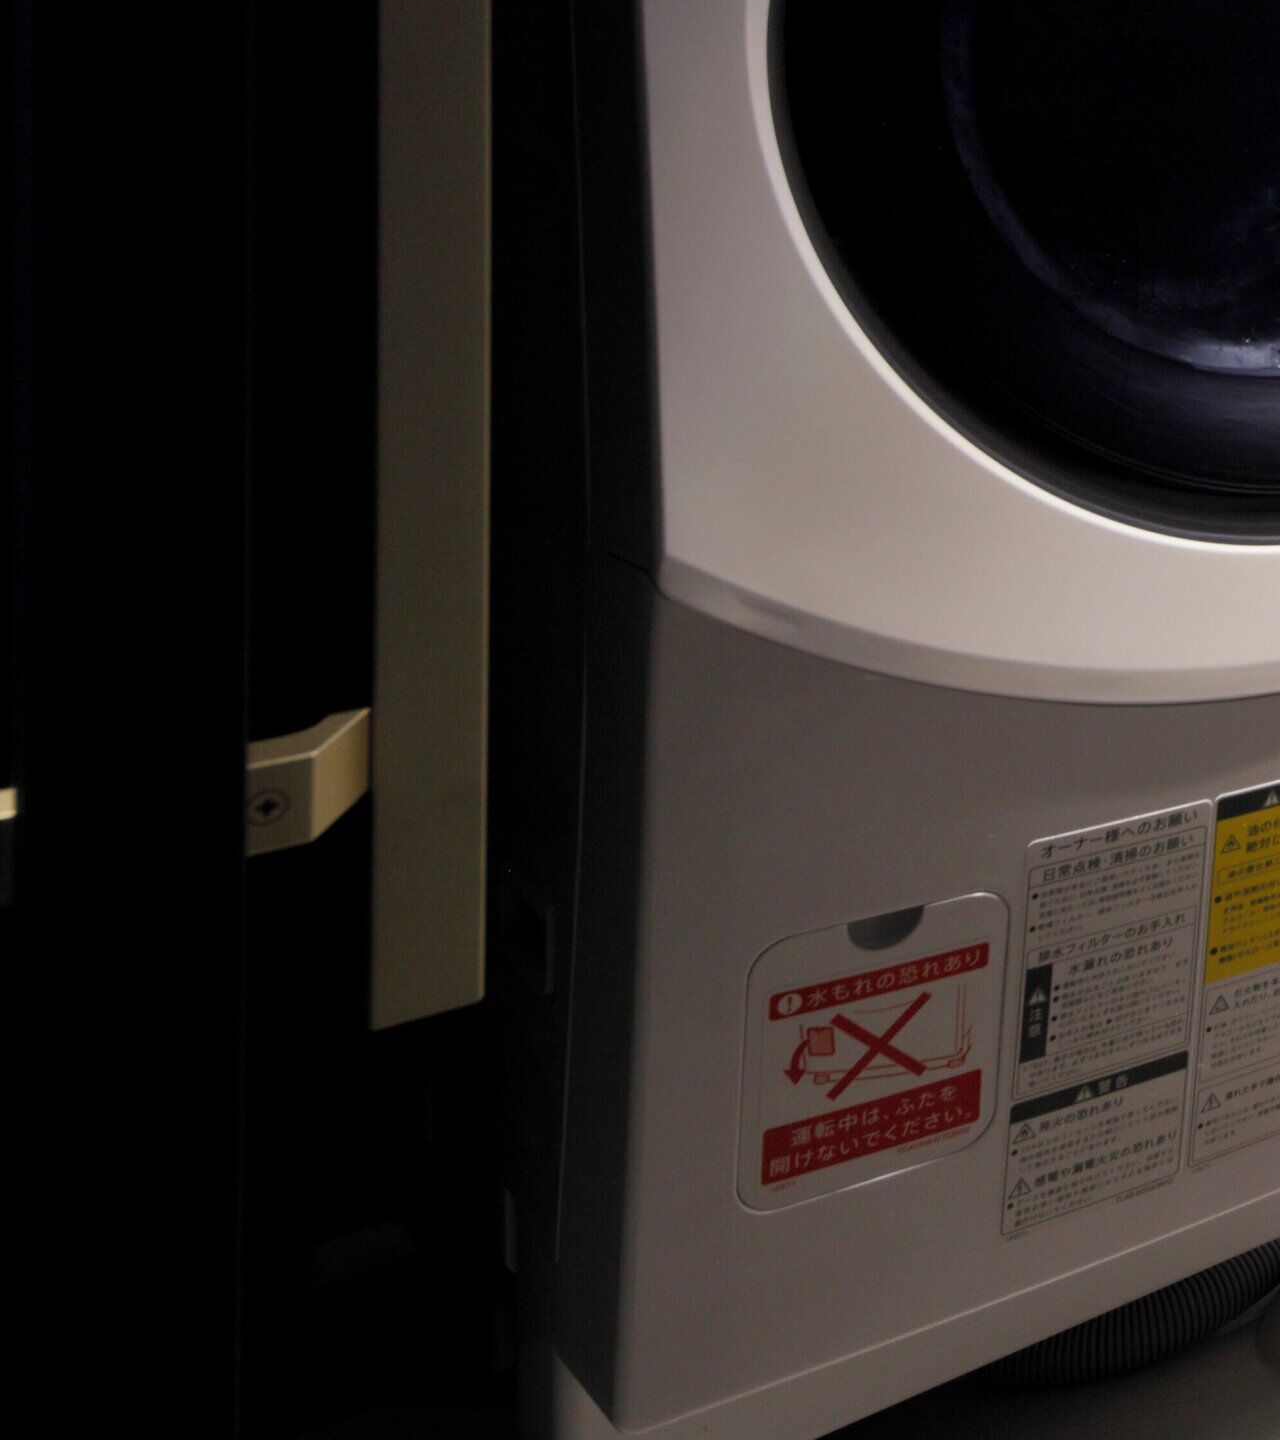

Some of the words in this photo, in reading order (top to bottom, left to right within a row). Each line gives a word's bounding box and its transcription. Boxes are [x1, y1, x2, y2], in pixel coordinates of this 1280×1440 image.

[1041, 808, 1198, 859] オーナー様へのお願い
[1042, 832, 1194, 882] 日常点検・清掃のお願い
[1038, 911, 1185, 963] 排水フィルターのお手入れ
[1068, 934, 1173, 976] 水漏れの恐れあり
[807, 948, 980, 1008] 水もれの恐れあり
[768, 1100, 973, 1178] 開けないでください。
[791, 1083, 957, 1148] 運転中は、ふたを
[1039, 1095, 1123, 1134] 発火の恐れあり
